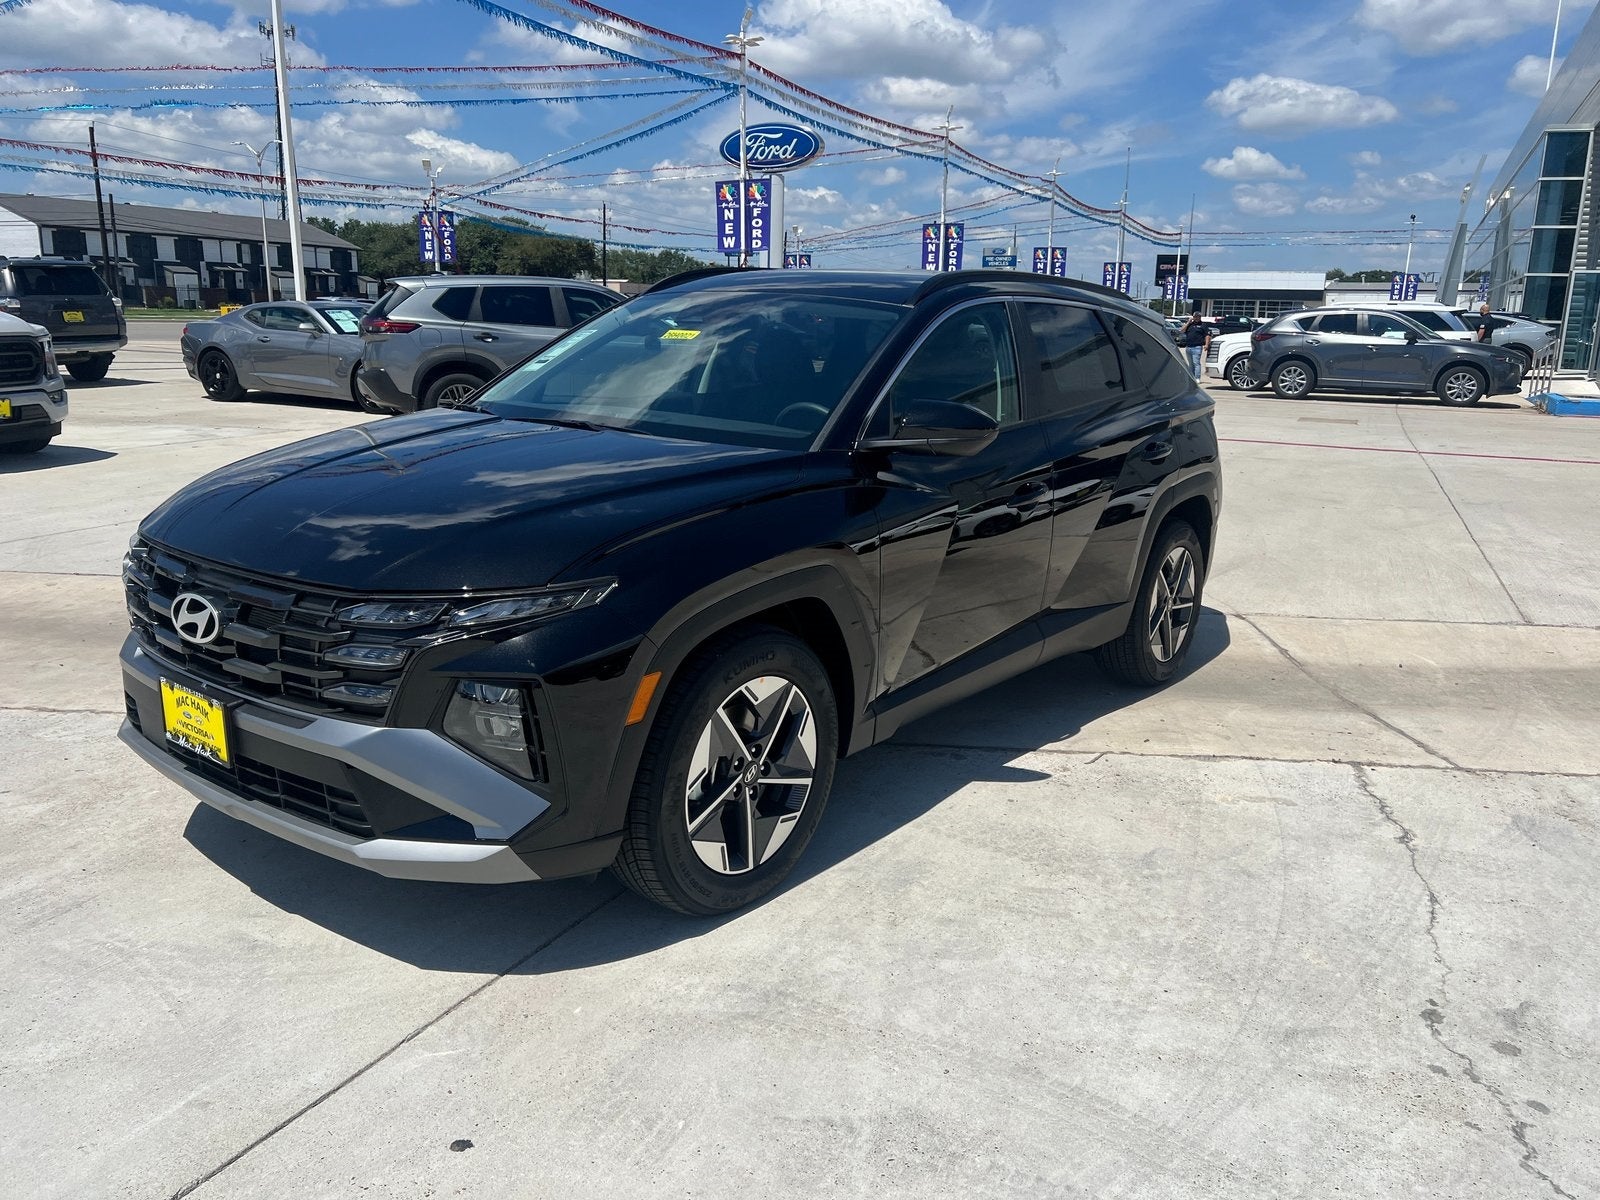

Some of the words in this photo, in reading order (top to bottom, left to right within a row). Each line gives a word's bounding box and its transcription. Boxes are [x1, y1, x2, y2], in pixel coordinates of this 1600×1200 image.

[745, 132, 798, 160] Ford
[723, 209, 735, 248] NEW
[751, 208, 762, 248] FORD
[424, 231, 433, 260] NEW
[443, 231, 452, 260] FORD
[926, 243, 936, 271] NEW
[948, 243, 958, 272] FORD
[1054, 262, 1062, 277] FO
[1392, 284, 1400, 300] NEW
[723, 650, 776, 685] KUMHO
[175, 696, 190, 708] MAC
[190, 698, 210, 722] HAIK
